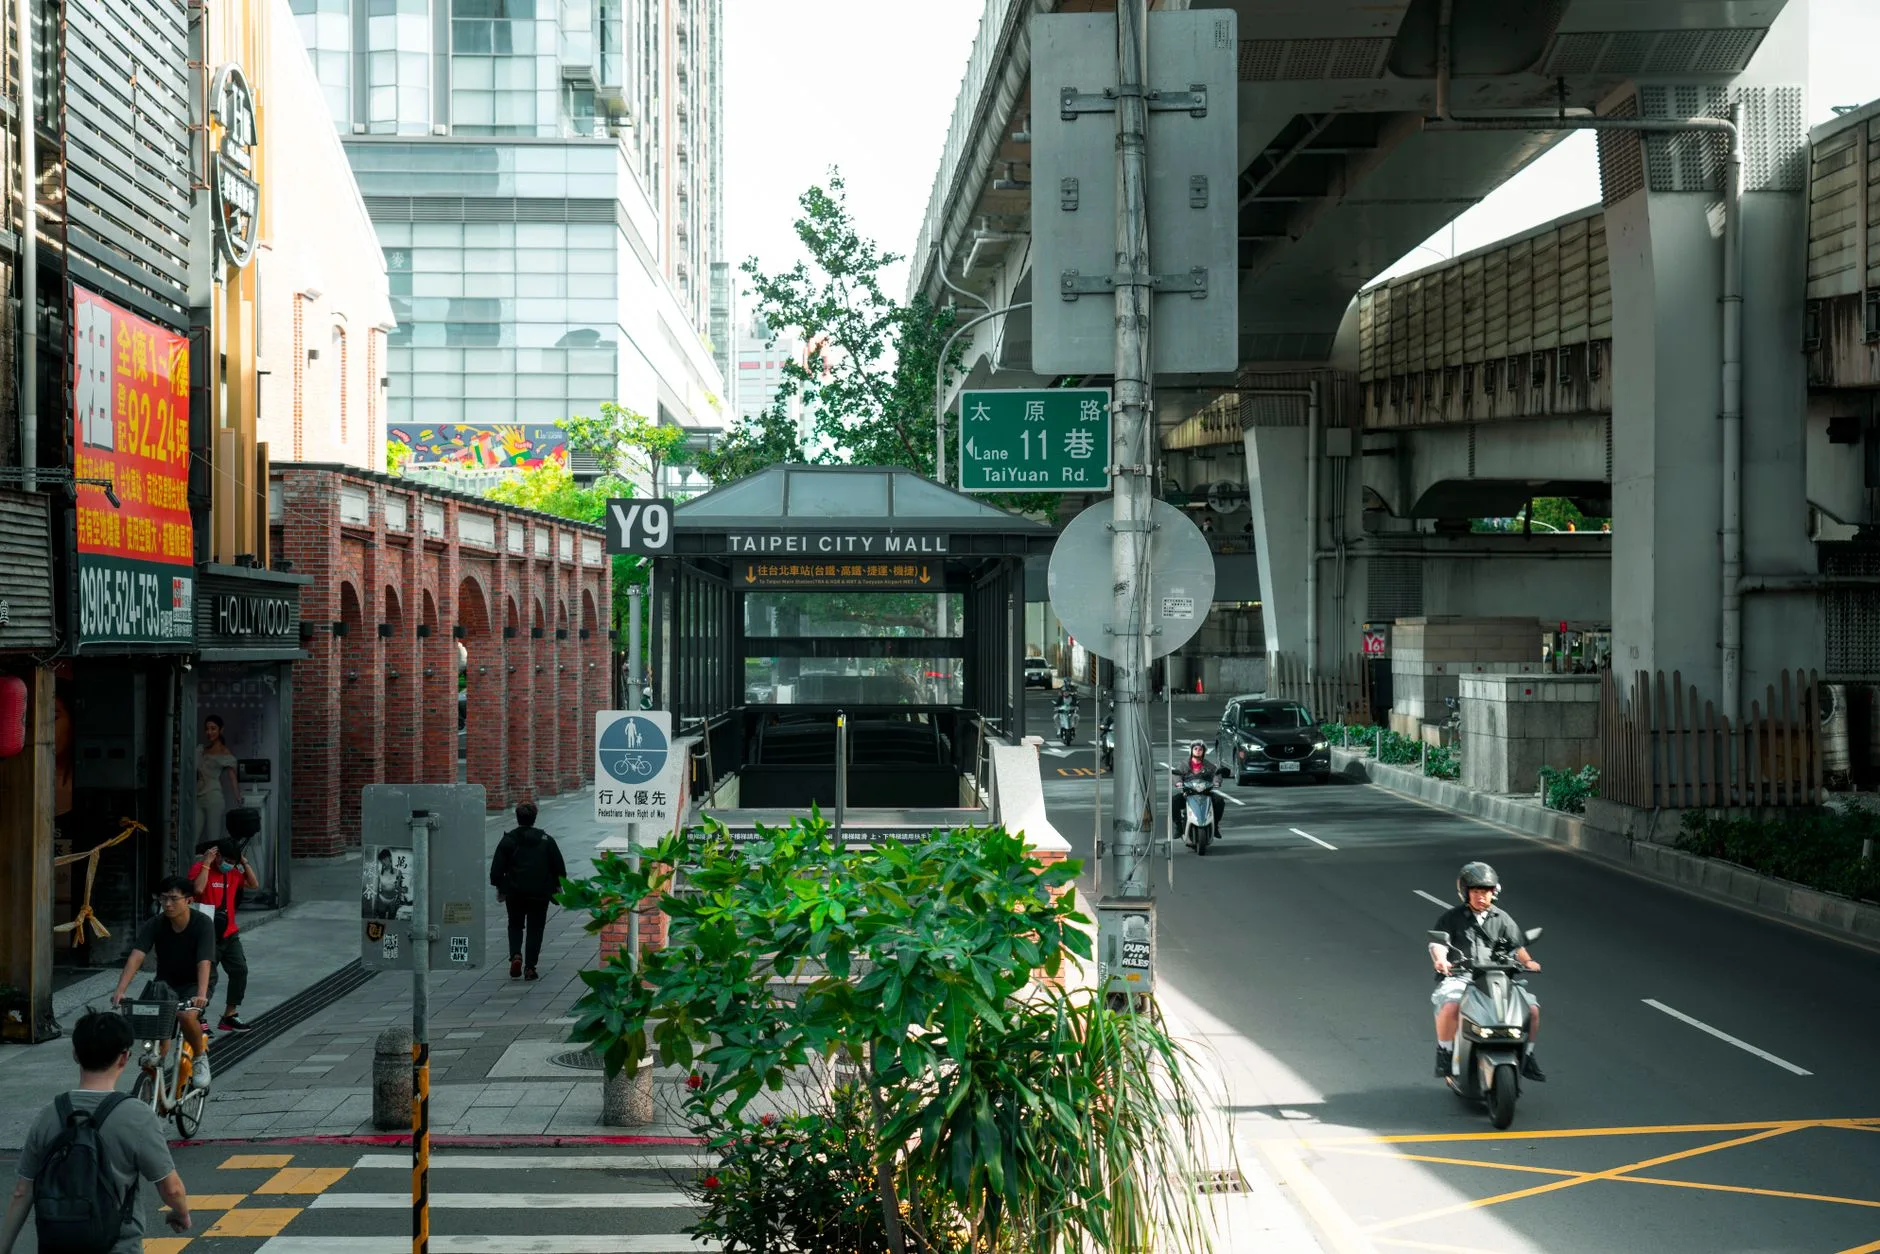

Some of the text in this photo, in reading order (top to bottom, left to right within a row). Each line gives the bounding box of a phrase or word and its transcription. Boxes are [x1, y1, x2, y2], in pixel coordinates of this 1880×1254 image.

[76, 299, 114, 452] 租
[974, 446, 1009, 461] Lane
[983, 467, 1089, 482] TaiYuan Rd.
[611, 504, 670, 549] Y9
[729, 535, 947, 552] TAIPEI CITY MALL
[81, 567, 160, 637] 0905-524-753
[219, 595, 291, 635] HOLLYWOOD
[598, 789, 667, 806] 行人優先
[598, 808, 623, 818] Pedestrians
[625, 809, 635, 818] Have
[452, 938, 467, 946] FINE
